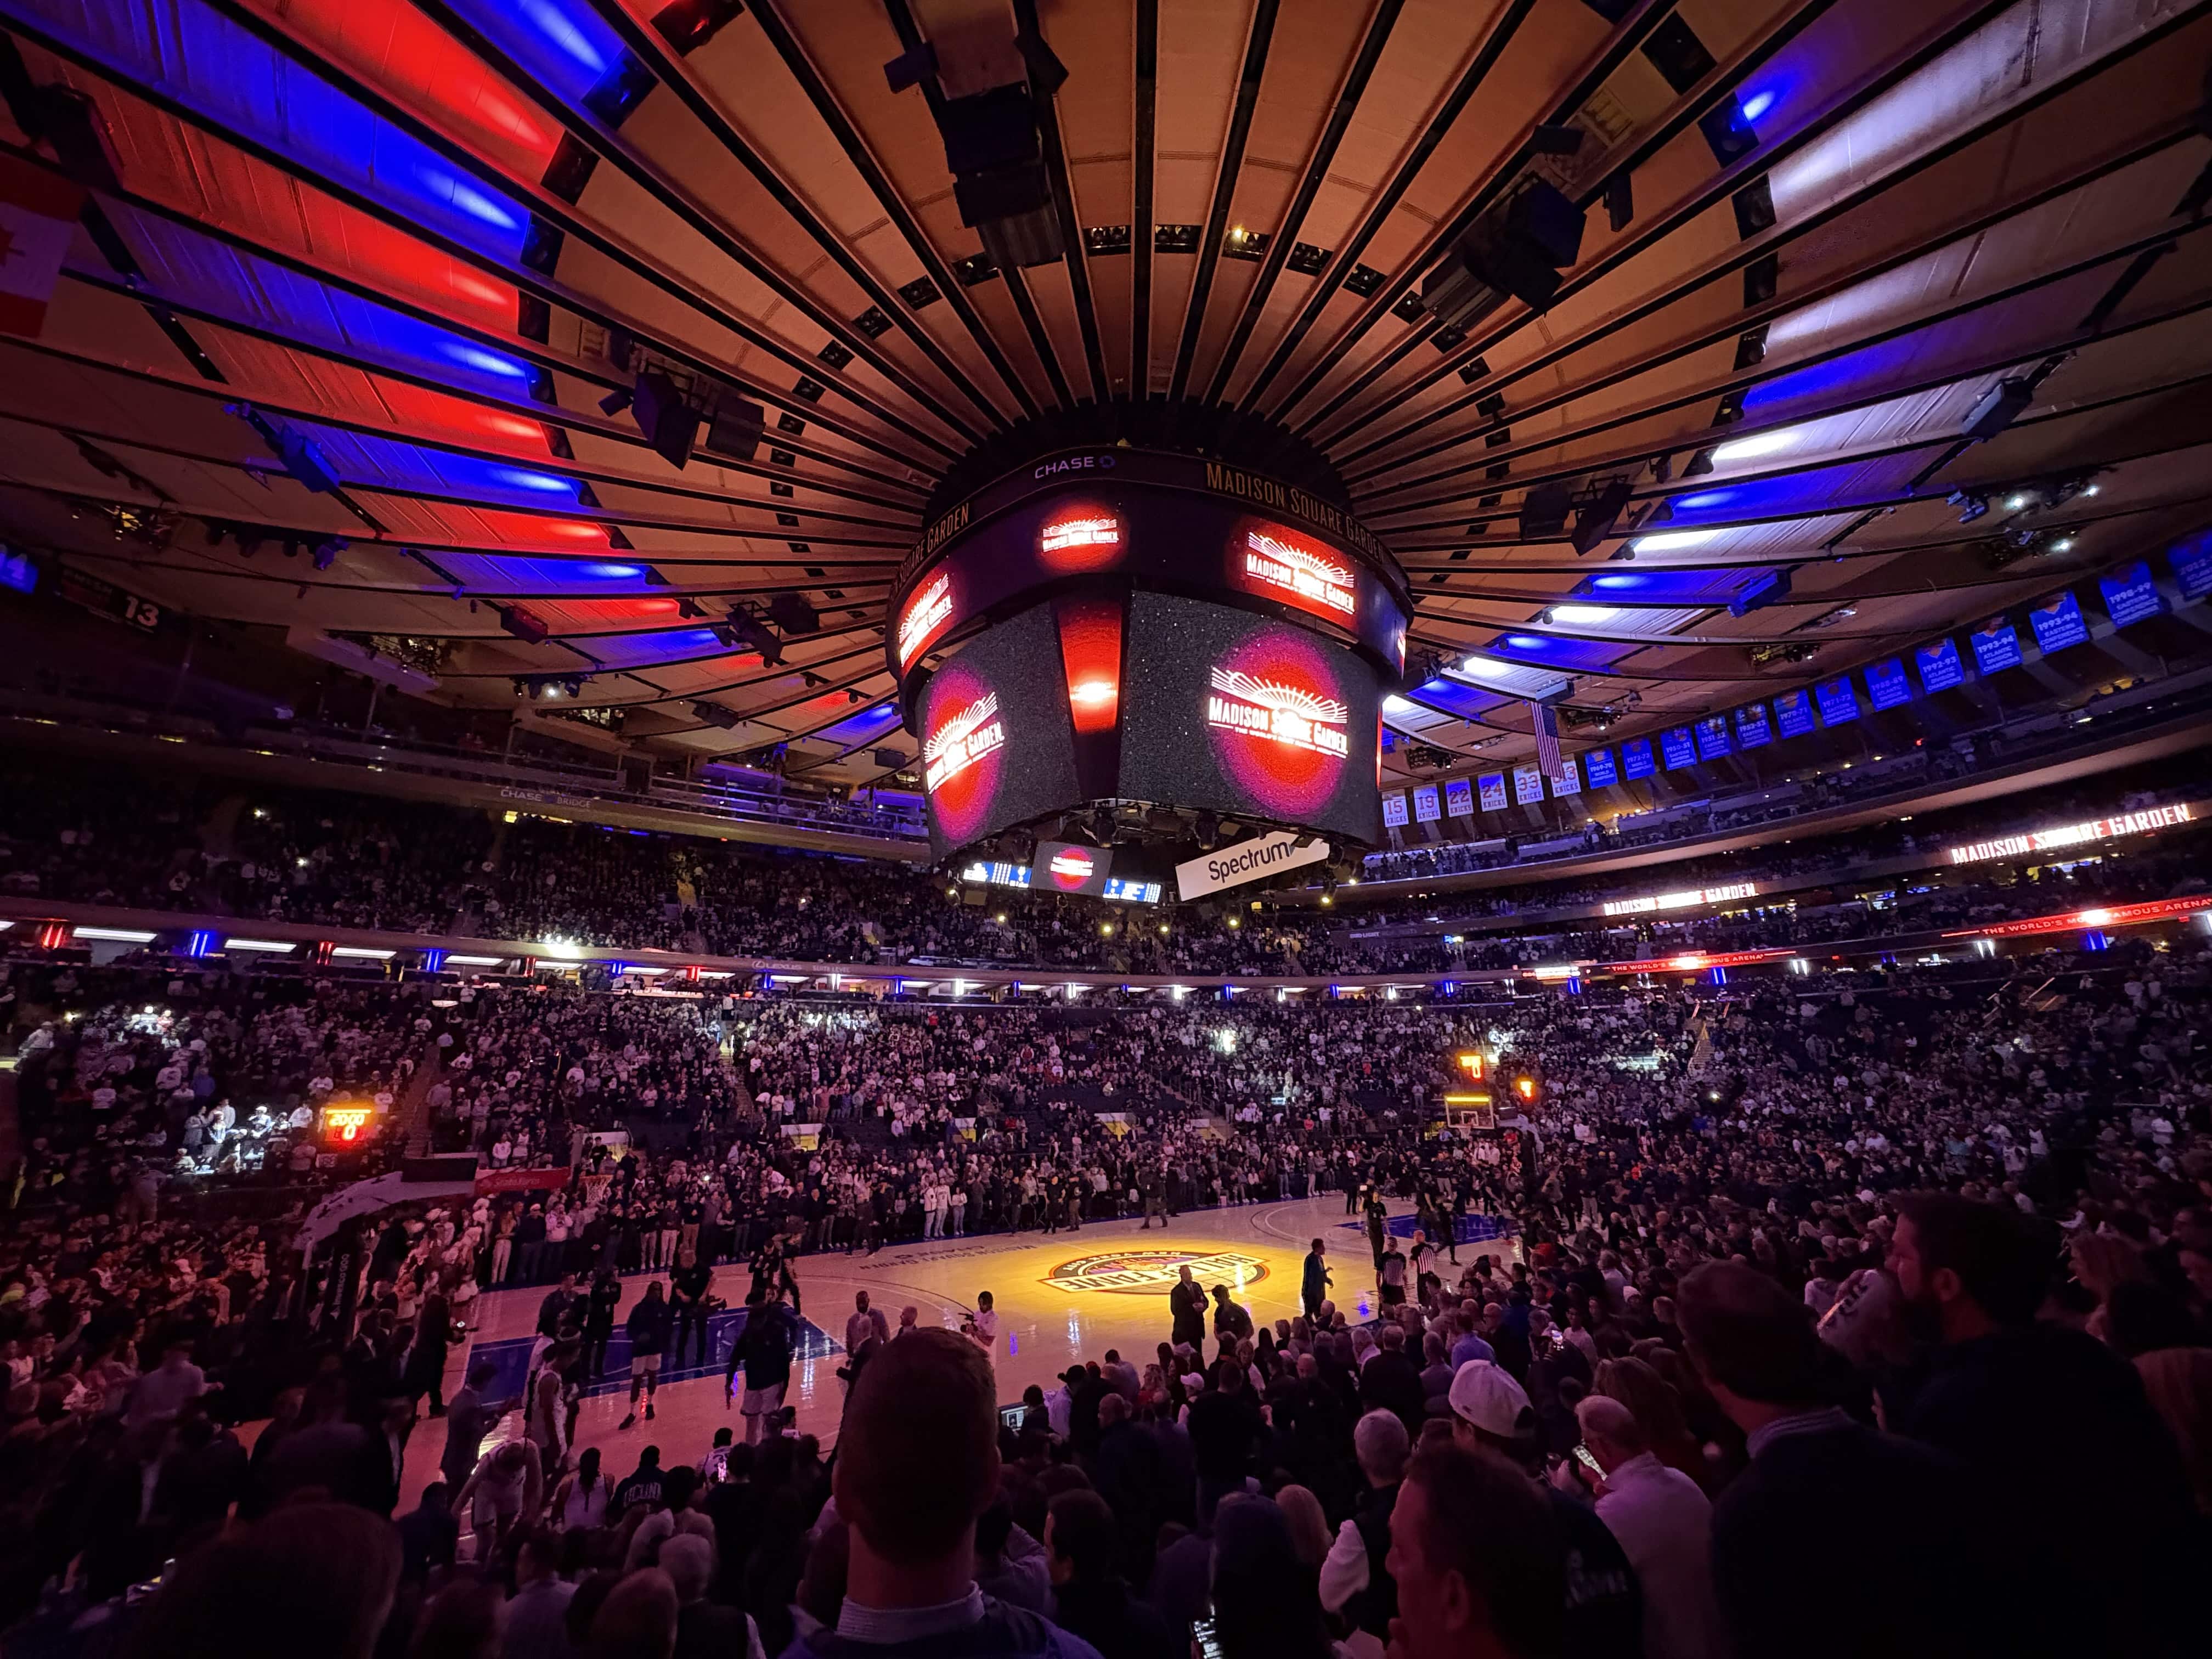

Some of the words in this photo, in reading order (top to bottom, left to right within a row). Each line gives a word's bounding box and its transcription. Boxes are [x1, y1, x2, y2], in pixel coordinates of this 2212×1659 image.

[1035, 456, 1096, 479] CHASE
[1206, 462, 1286, 509] MADISON
[1290, 488, 1342, 535] SQUARE
[1346, 516, 1384, 563] GARDEN
[927, 502, 970, 553] GARDEN
[125, 594, 159, 627] 13
[2038, 611, 2078, 631] 1993-94
[1977, 635, 2015, 653] 1993-94
[1923, 656, 1957, 673] 1992-93
[1209, 697, 1269, 731] MADISON
[967, 722, 1006, 756] GARDEN
[1482, 782, 1503, 799] 24
[1517, 774, 1539, 791] 33
[1554, 783, 1579, 794] KNICKS
[500, 789, 543, 802] CHASE
[557, 797, 592, 808] BRIDGE
[1419, 795, 1435, 810] 19
[1449, 788, 1470, 805] 22
[1483, 798, 1506, 809] KNICKS
[1519, 791, 1542, 802] KNICKS
[1386, 800, 1403, 815] 15
[1418, 810, 1439, 820] KNICKS
[1450, 804, 1472, 814] KNICKS
[1386, 815, 1407, 825] KNICKS
[1951, 834, 2030, 865] MADISON
[2108, 803, 2193, 836] GARDEN
[1207, 841, 1290, 884] Spectrum
[1604, 897, 1656, 916] MADISON
[1982, 924, 2006, 936] THE
[2007, 919, 2063, 933] WORLD'S
[1629, 962, 1667, 970] WORLD'S
[342, 1125, 357, 1140] 0
[1054, 1271, 1153, 1290] FAME
